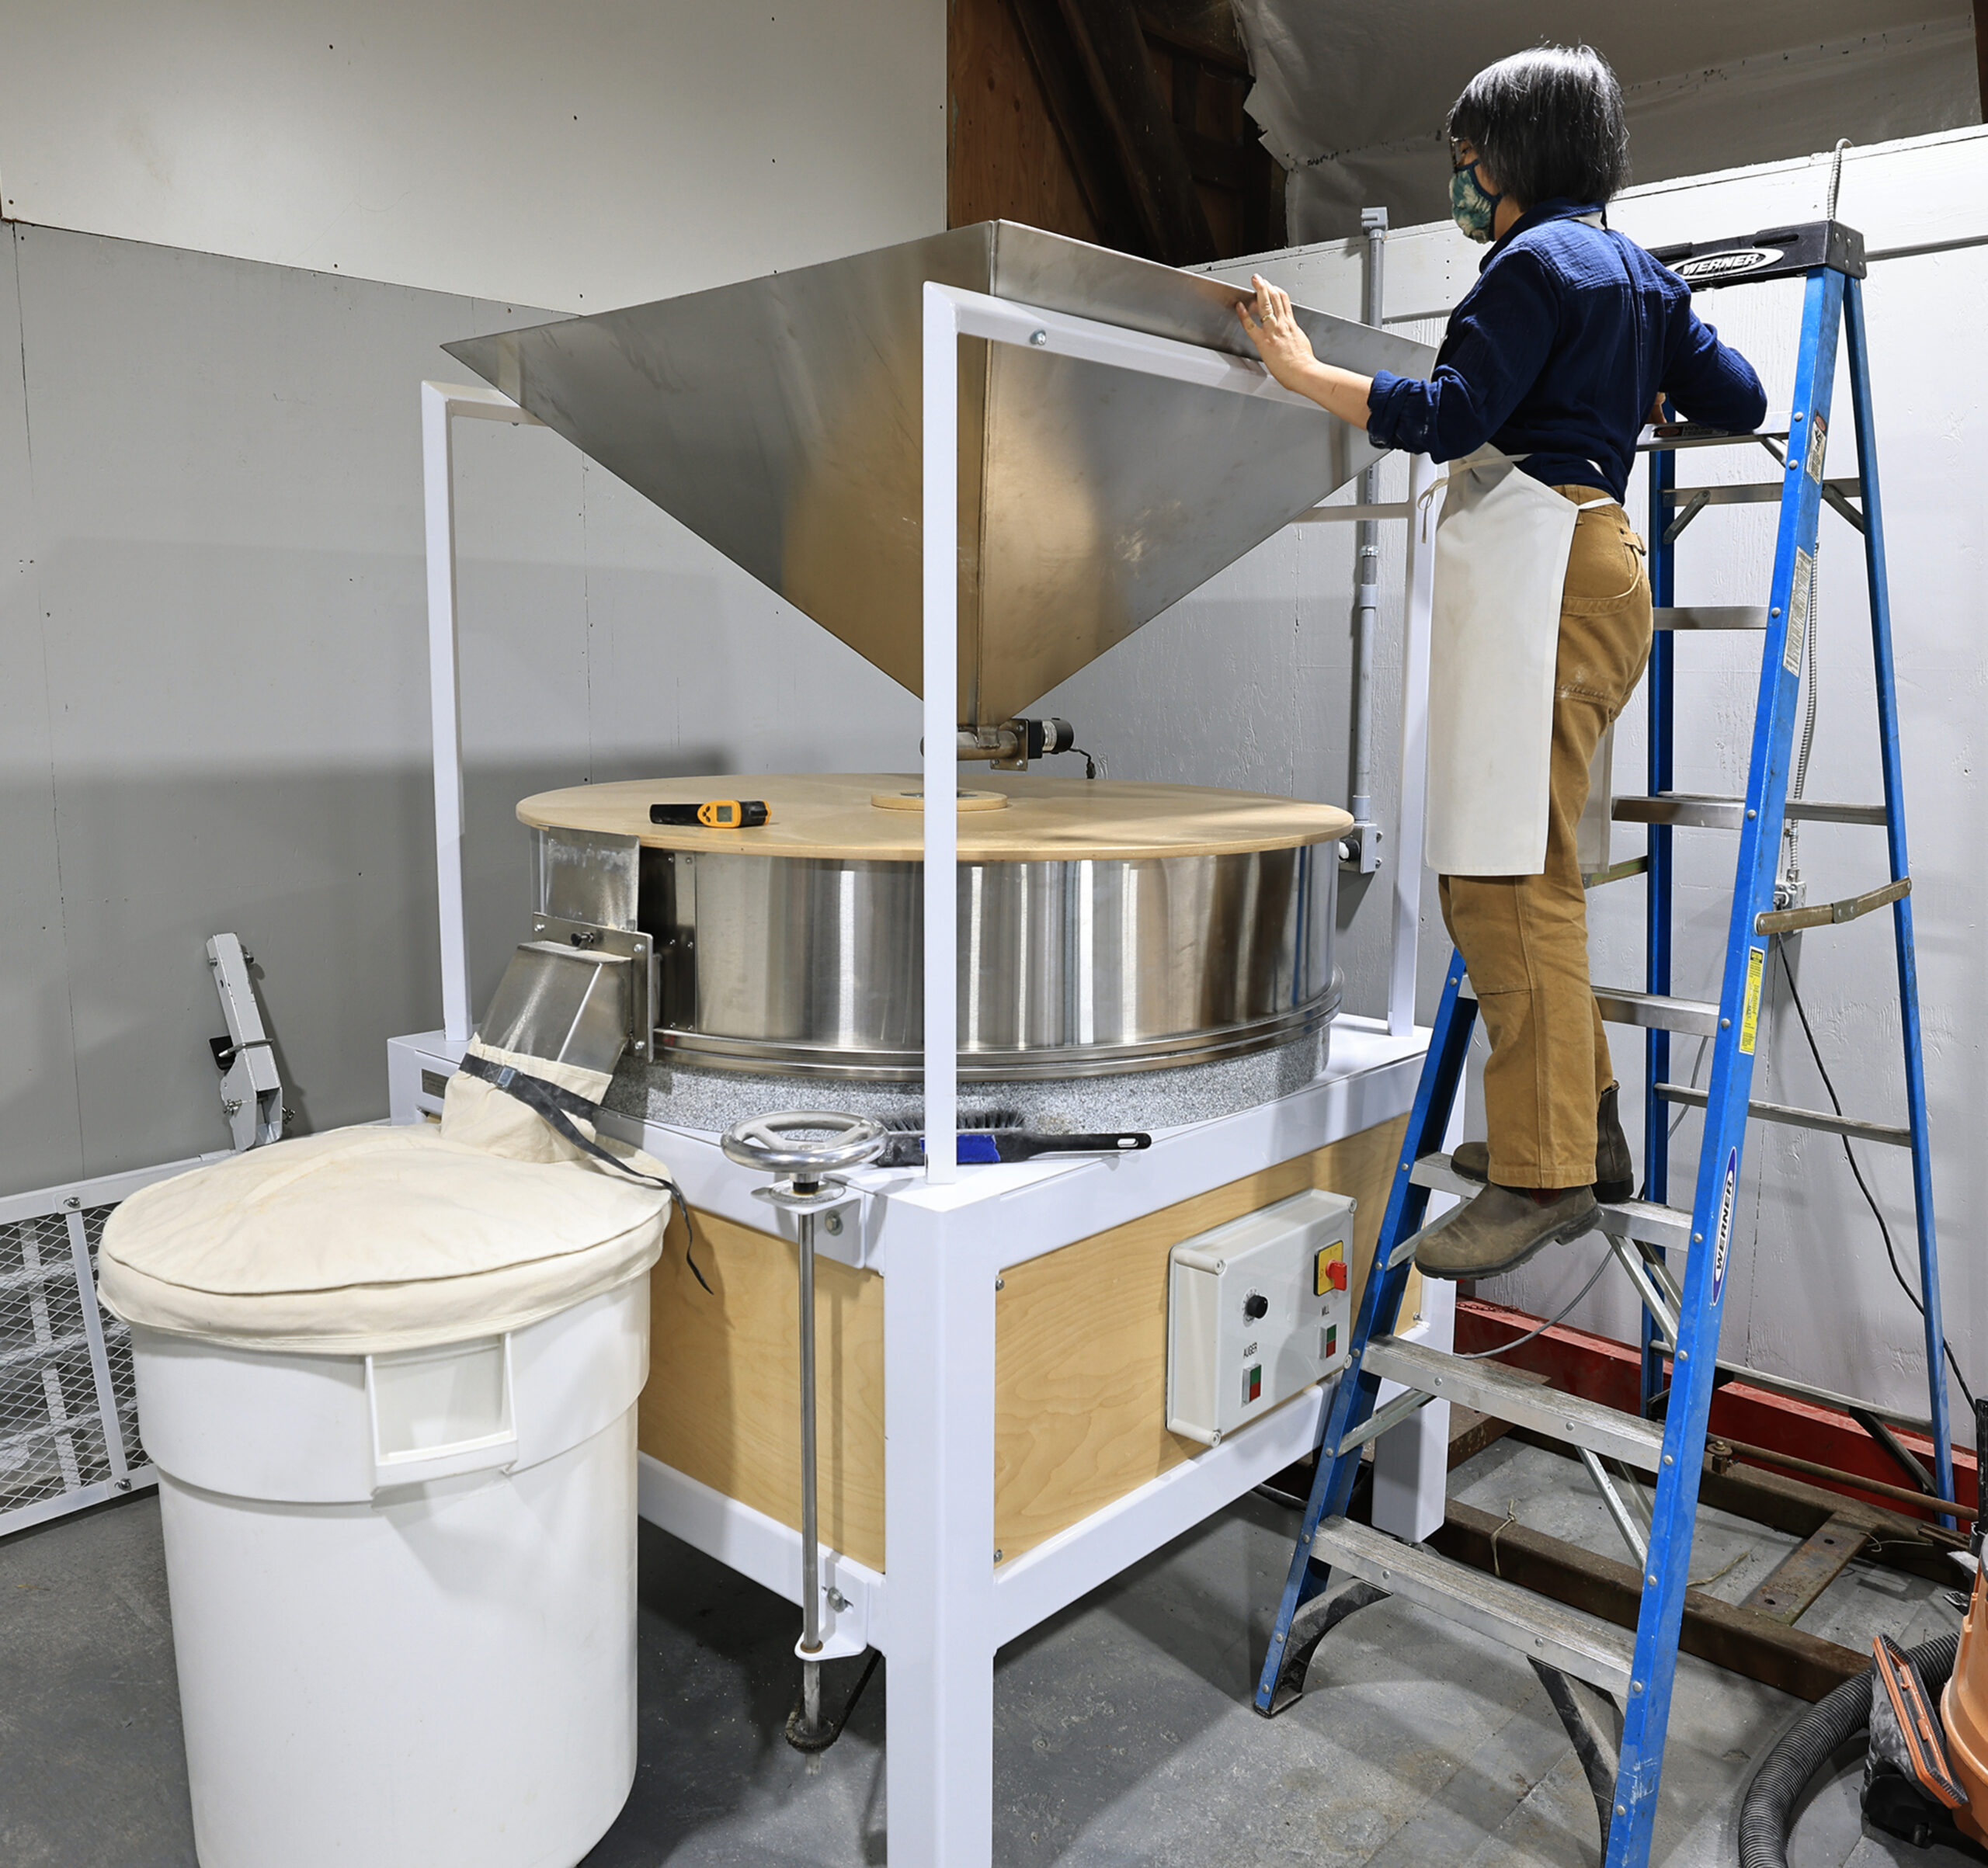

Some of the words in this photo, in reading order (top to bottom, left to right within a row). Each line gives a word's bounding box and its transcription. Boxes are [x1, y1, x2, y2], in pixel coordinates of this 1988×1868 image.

[1682, 253, 1760, 276] WERNER
[1716, 1180, 1733, 1271] WERNER
[1243, 1342, 1258, 1358] AUGER
